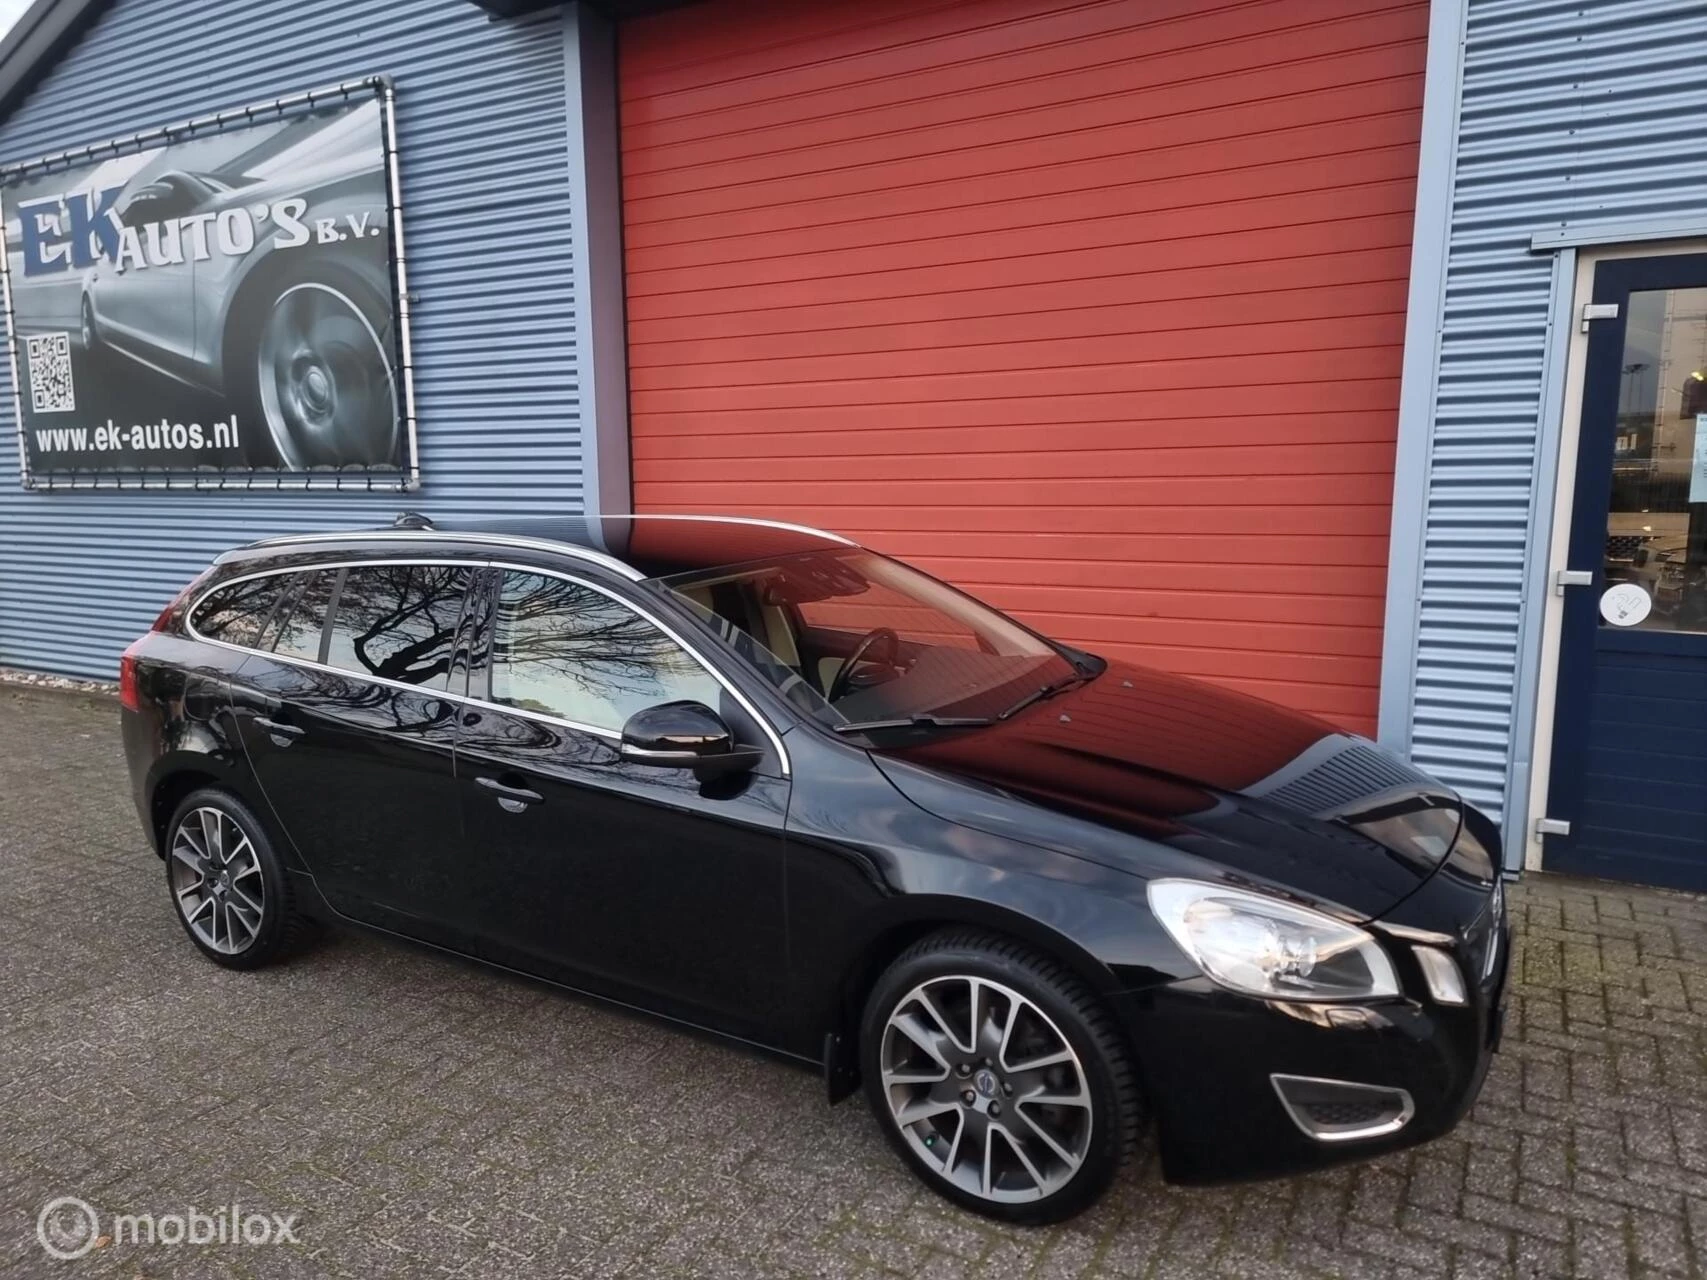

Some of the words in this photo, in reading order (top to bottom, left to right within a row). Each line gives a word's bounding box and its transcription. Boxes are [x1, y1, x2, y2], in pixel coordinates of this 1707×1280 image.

[17, 185, 126, 277] EK
[316, 211, 381, 245] B.V.
[36, 415, 240, 453] www.ek-autos.nl
